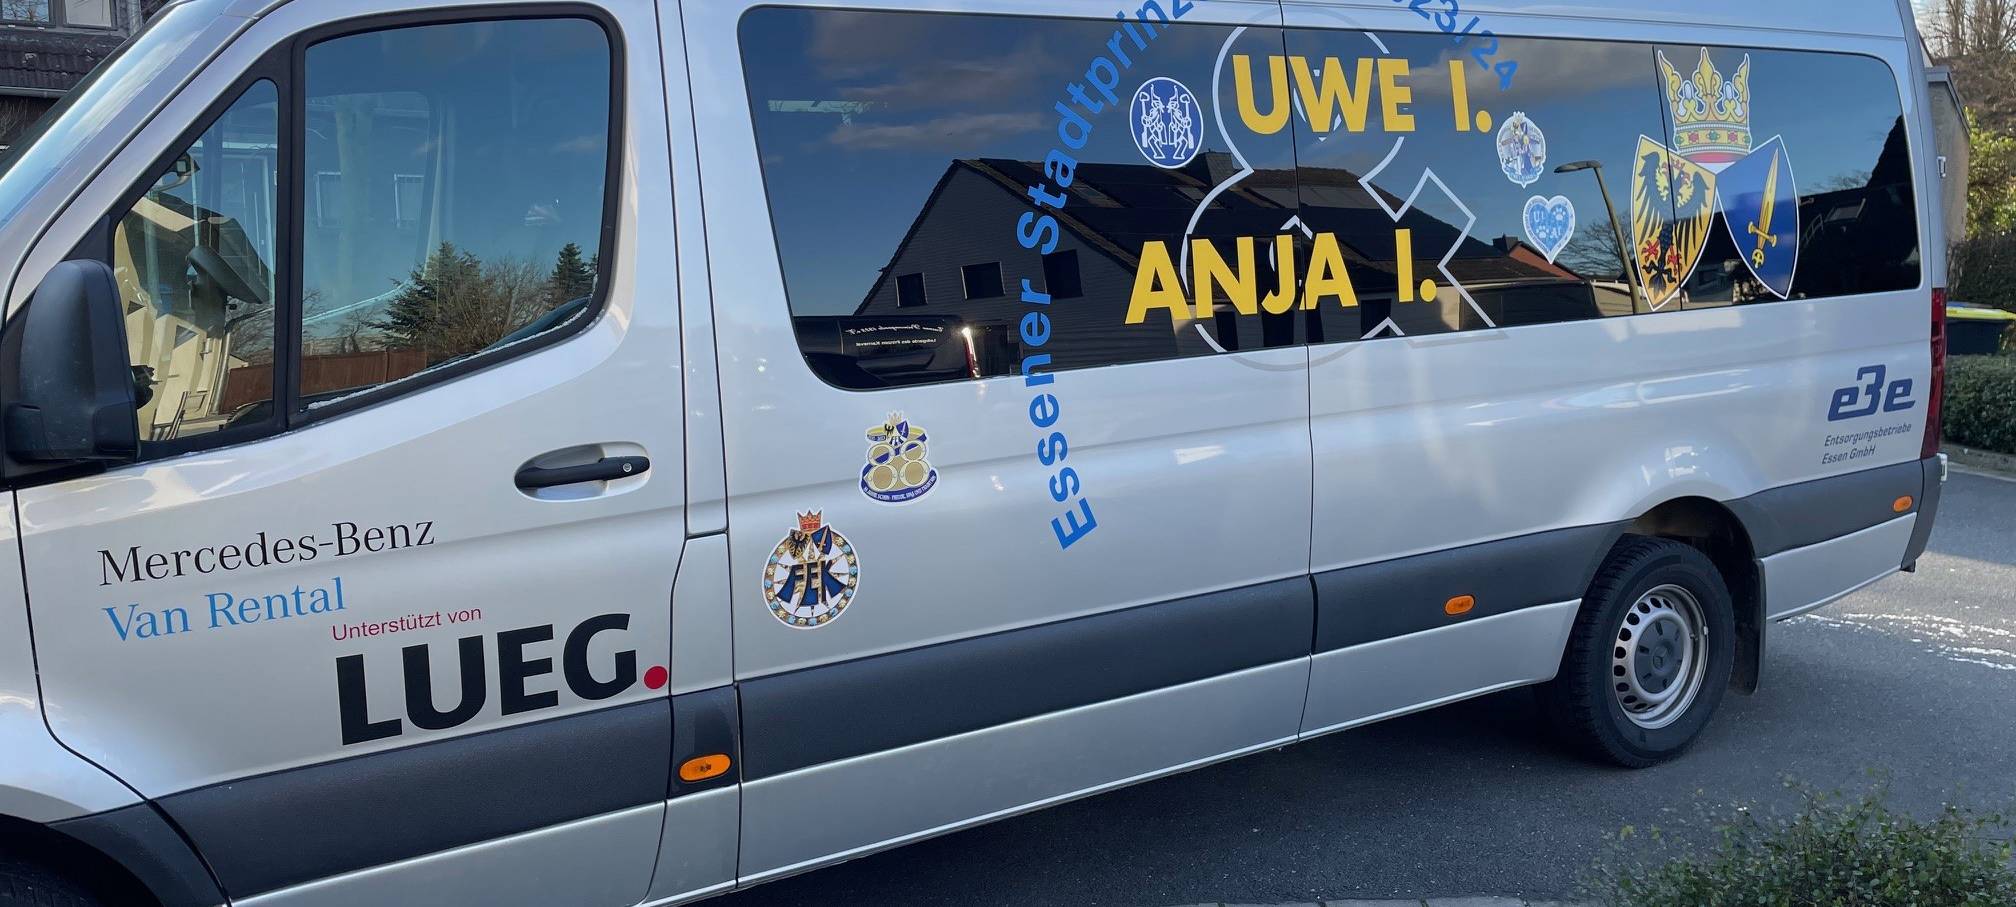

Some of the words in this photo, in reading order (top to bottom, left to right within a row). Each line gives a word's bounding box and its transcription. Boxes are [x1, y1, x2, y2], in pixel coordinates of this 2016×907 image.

[1231, 54, 1416, 135] UWE
[1448, 60, 1493, 133] I.
[1125, 231, 1358, 325] ANJA
[1395, 228, 1438, 304] I.
[1018, 278, 1099, 551] Essener
[1824, 423, 1912, 447] Entsorgungsbetriebe
[1822, 452, 1848, 465] Essen
[1849, 445, 1876, 460] GmbH
[97, 520, 436, 587] Mercedes-Benz
[775, 559, 848, 608] FEK
[103, 606, 190, 641] Van
[205, 576, 348, 630] Rental
[332, 611, 441, 641] Unterstützt
[448, 607, 482, 623] von
[334, 612, 669, 747] LUEG.
